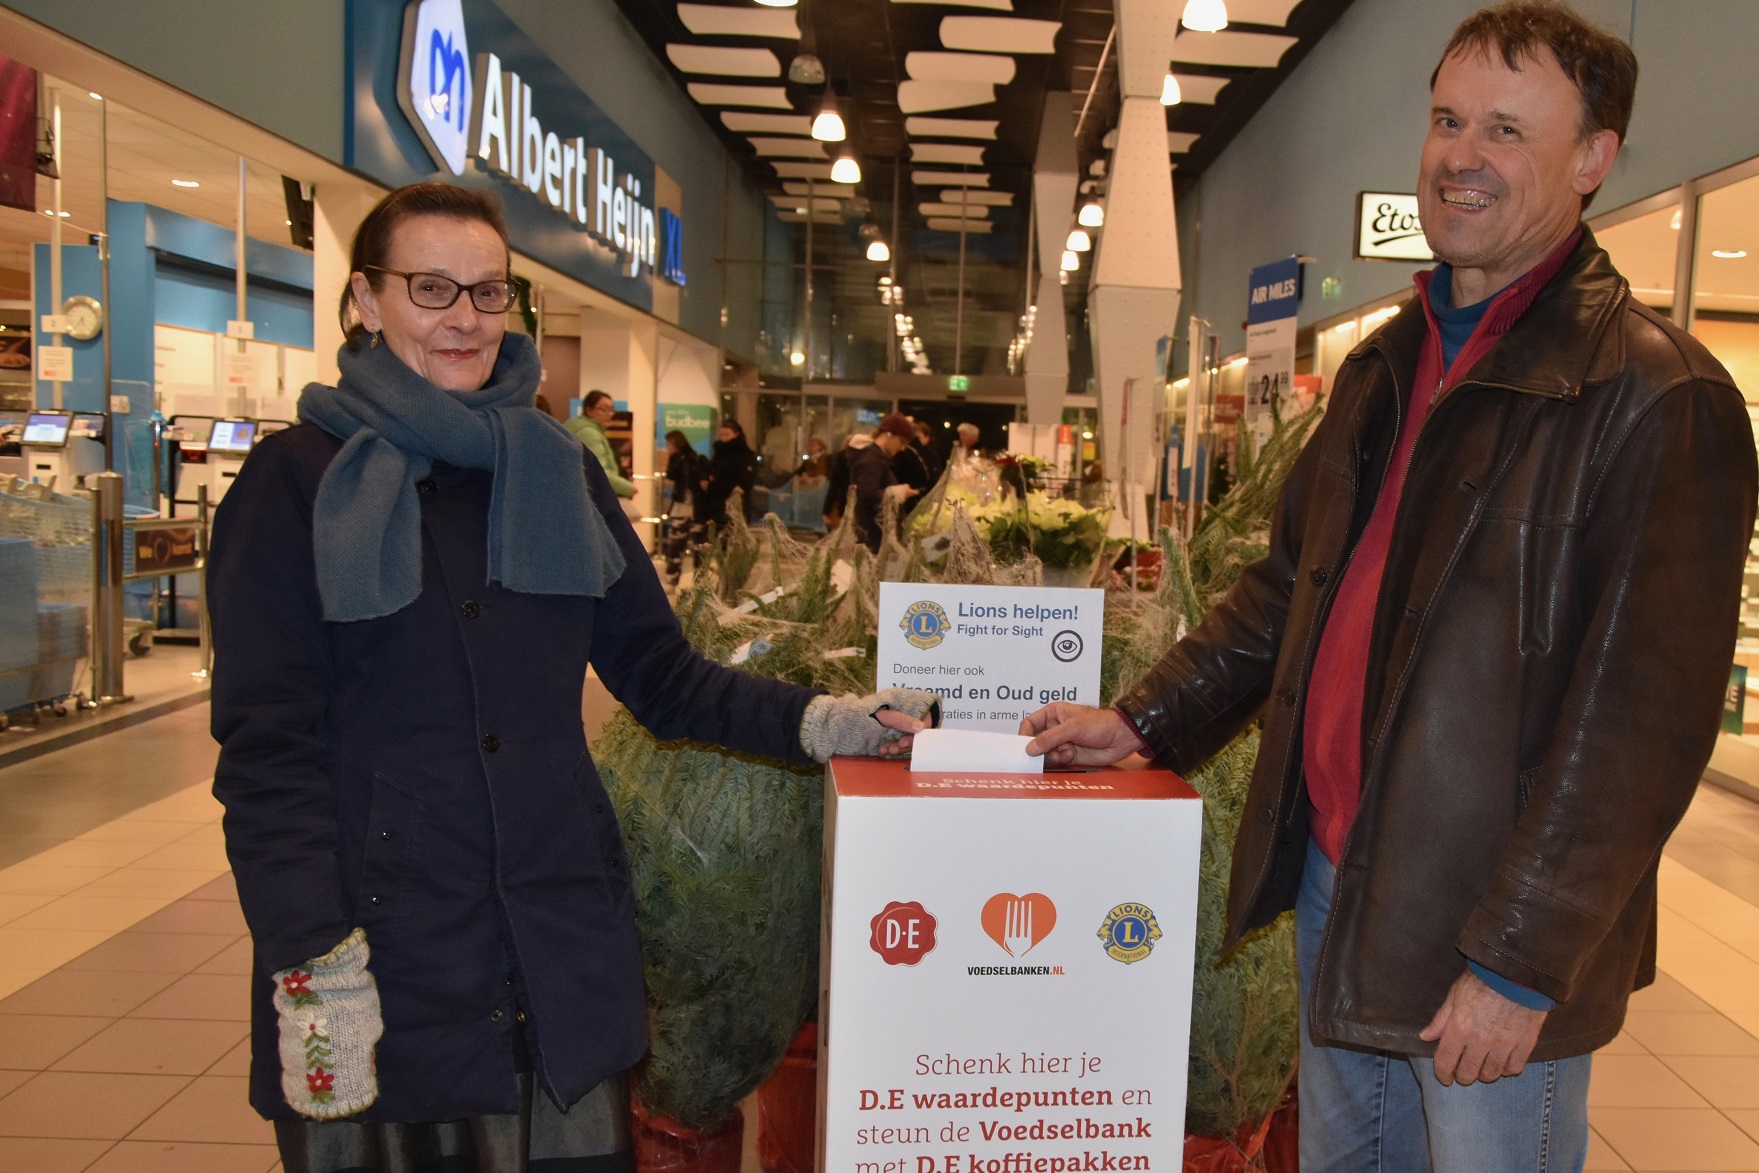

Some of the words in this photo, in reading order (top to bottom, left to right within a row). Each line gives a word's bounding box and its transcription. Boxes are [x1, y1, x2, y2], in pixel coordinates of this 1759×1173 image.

[479, 52, 588, 225] Albert
[596, 147, 656, 278] Heijn
[660, 207, 686, 286] XL
[1251, 285, 1268, 305] AIR
[1268, 278, 1296, 301] MILES
[665, 413, 711, 429] budbee
[911, 602, 941, 614] LIONS
[958, 602, 1008, 619] Lions
[1013, 603, 1079, 623] helpen!
[919, 615, 933, 633] L
[957, 624, 989, 637] Fight
[991, 624, 1009, 636] for
[1011, 625, 1044, 638] Sight
[893, 663, 936, 676] Doneer
[939, 664, 961, 676] hier
[964, 665, 985, 676] ook
[892, 682, 963, 700] emd
[968, 687, 990, 700] en
[996, 684, 1034, 701] Oud
[1039, 686, 1078, 705] geld
[976, 710, 986, 720] in
[989, 711, 1019, 721] arme
[957, 782, 1115, 791] waardepunten
[1023, 778, 1058, 786] hier
[1065, 779, 1081, 787] je
[1112, 904, 1150, 918] LIONS
[1122, 921, 1139, 943] L
[1110, 948, 1148, 959] INTERNATIONAL
[967, 966, 1066, 976] VOEDSELBANKEN.NL
[915, 1053, 1012, 1076] Schenk
[1020, 1052, 1073, 1074] hier
[1078, 1052, 1102, 1079] je
[858, 1088, 905, 1111] D.E
[912, 1086, 1113, 1113] waardepunten
[1121, 1089, 1152, 1106] en
[856, 1124, 931, 1145] steun
[939, 1121, 970, 1143] de
[978, 1117, 1152, 1142] Voedselbank
[854, 1157, 907, 1173] met
[916, 1155, 961, 1173] D.E
[968, 1151, 1151, 1173] koffiepakken
